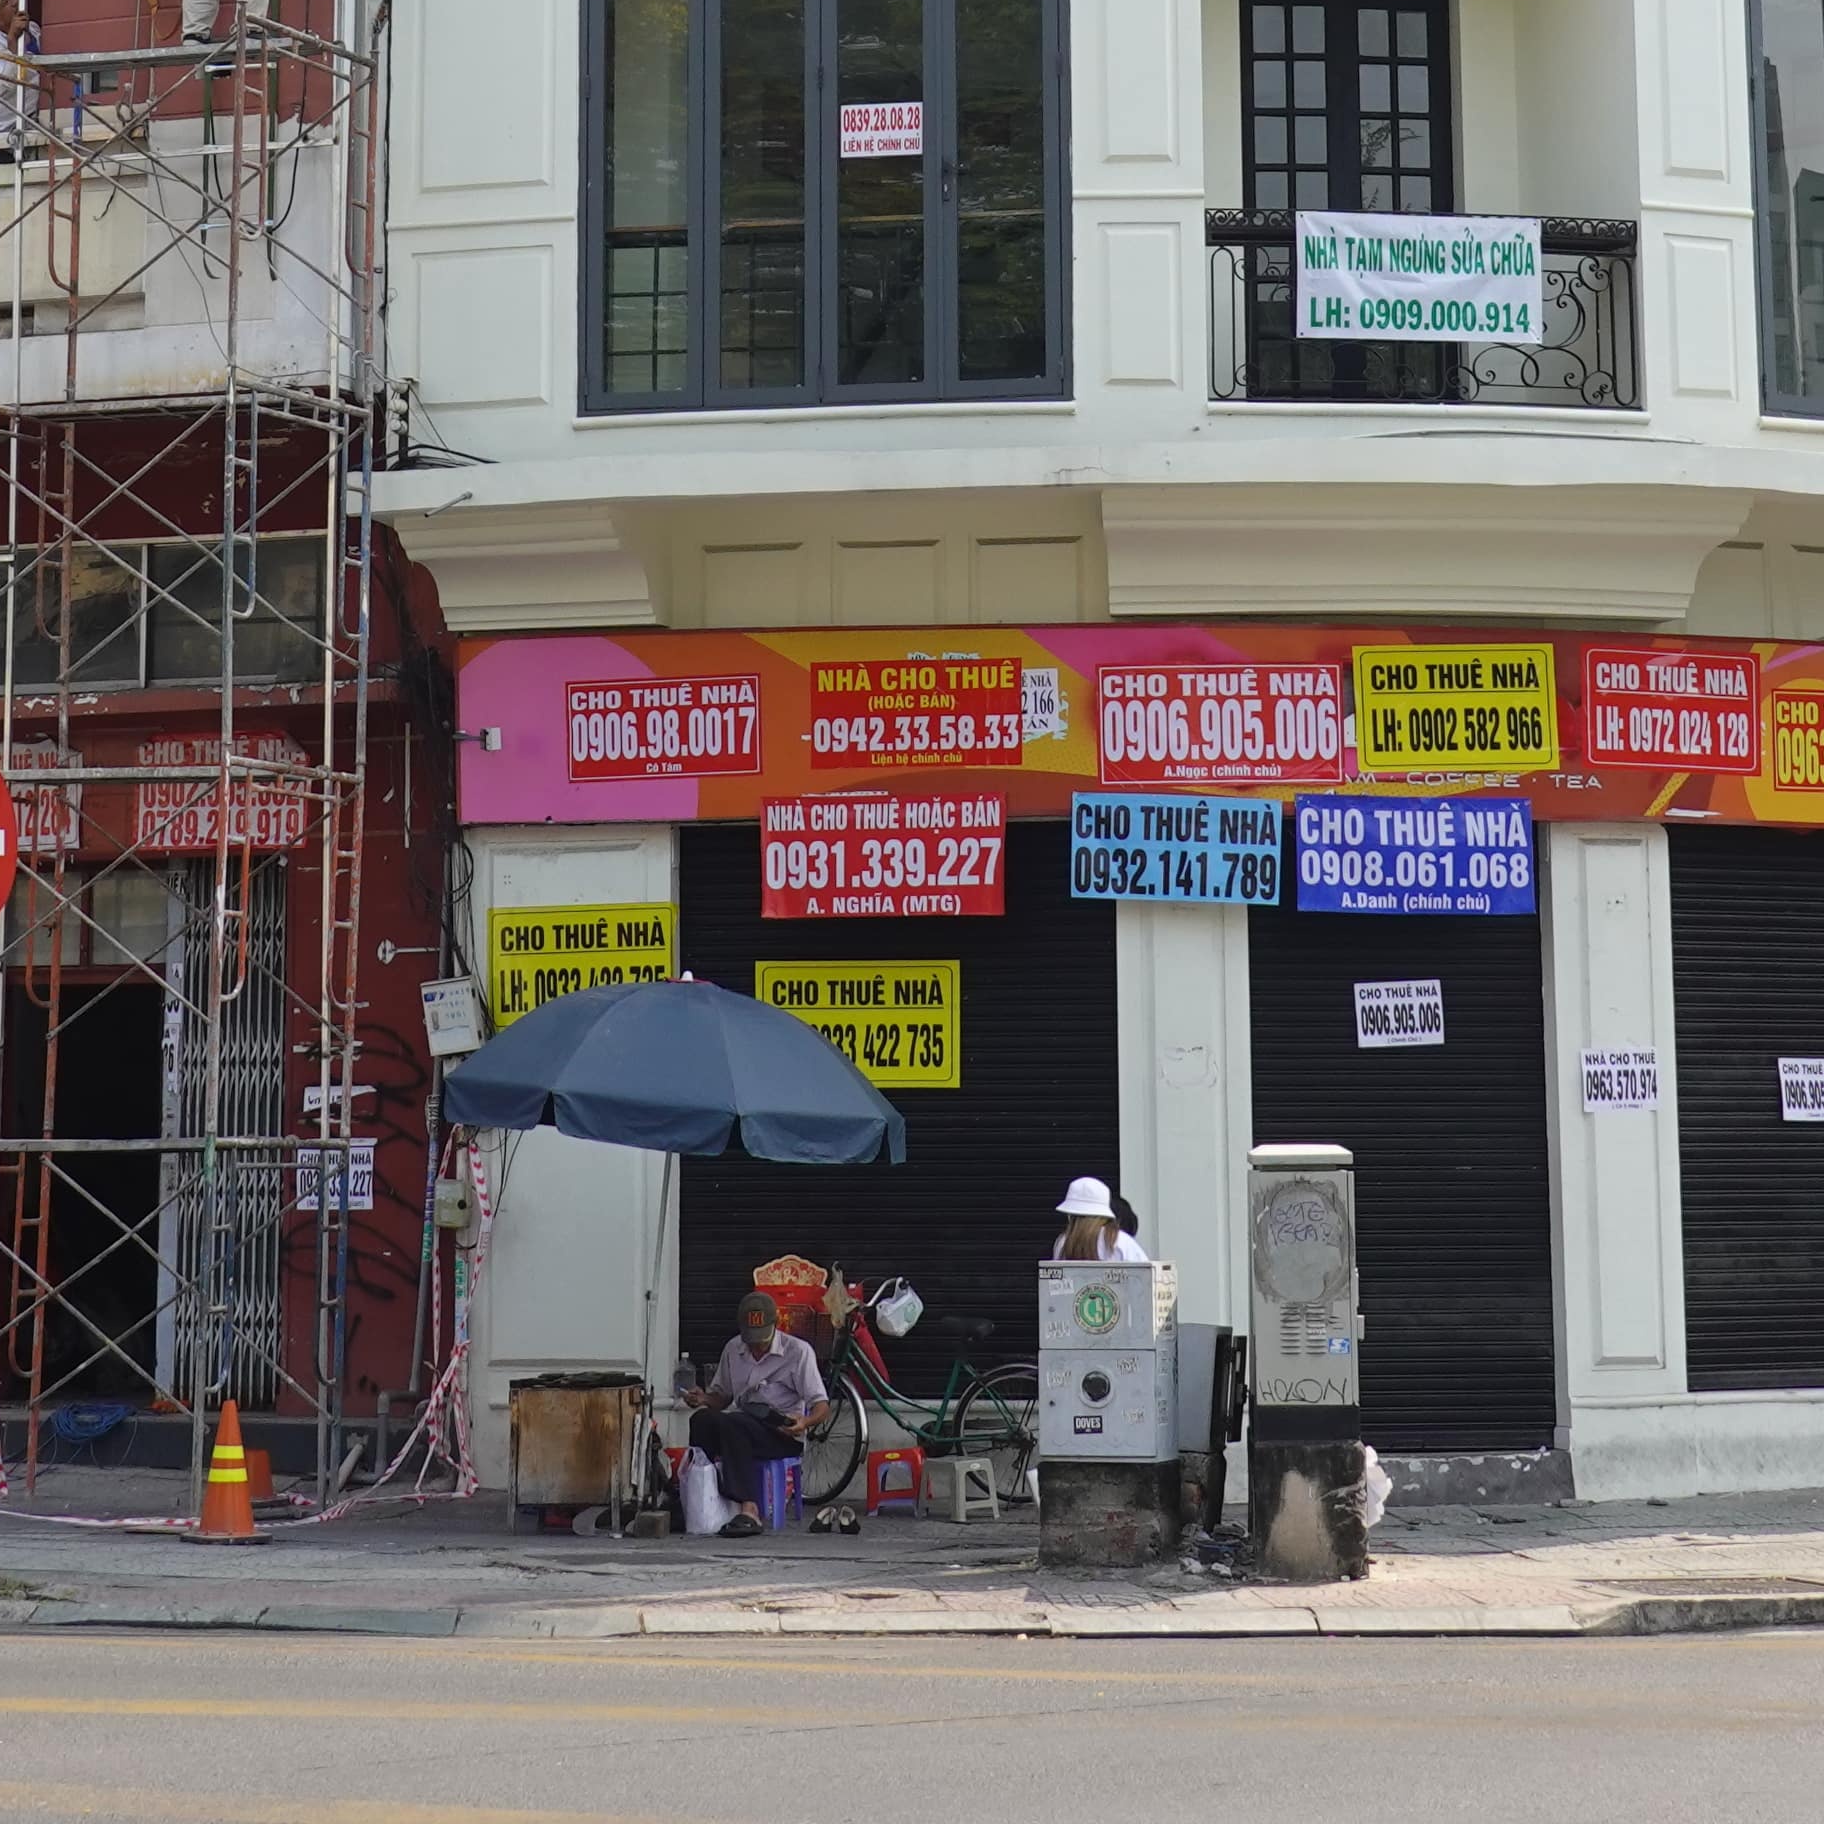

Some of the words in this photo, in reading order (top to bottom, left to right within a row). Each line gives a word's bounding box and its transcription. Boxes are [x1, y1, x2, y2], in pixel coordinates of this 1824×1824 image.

[844, 106, 920, 133] 0839.28.08.28
[844, 136, 862, 152] LIÊN
[864, 138, 874, 154] HỆ
[878, 132, 901, 150] CHÍNH
[904, 133, 920, 149] CHỦ
[1305, 227, 1338, 270] NHÀ
[1345, 238, 1383, 279] TẠM
[1390, 239, 1446, 274] NGƯNG
[1451, 227, 1485, 274] SỬA
[1490, 235, 1535, 277] CHỮA
[1310, 298, 1350, 328] LH:
[1360, 299, 1529, 333] 0909.000.914
[817, 664, 872, 692] NHÀ
[881, 667, 936, 690] CHO
[945, 660, 1015, 689] THUÊ
[1103, 675, 1167, 698] CHO
[1177, 669, 1261, 696] THUÊ
[1269, 668, 1336, 696] NHÀ
[1371, 666, 1417, 691] CHO
[1426, 659, 1484, 689] THUÊ
[1491, 662, 1540, 688] NHÀ
[1596, 663, 1639, 690] CHO
[1646, 662, 1699, 694] THUÊ
[1705, 664, 1748, 696] NHÀ
[572, 690, 621, 711] CHO
[630, 683, 692, 708] THUÊ
[702, 680, 755, 704] NHÀ
[868, 695, 915, 712] (HOẶC
[920, 692, 955, 710] BÁN)
[1777, 701, 1819, 724] CHO
[572, 707, 756, 762] 0906.98.0017
[814, 714, 1020, 752] 0942.33.58.33
[1103, 698, 1337, 762] 0906.905.006
[1374, 709, 1402, 754] LH:
[1408, 708, 1458, 751] 0902
[1464, 708, 1500, 751] 582
[1506, 708, 1542, 750] 966
[1596, 706, 1624, 750] LH:
[1629, 707, 1674, 753] 0972
[1679, 710, 1711, 755] 024
[1717, 712, 1749, 756] 128
[912, 752, 940, 763] chính
[944, 752, 962, 762] chủ
[1550, 775, 1602, 789] TEA
[767, 799, 805, 832] NHÀ
[811, 804, 848, 830] CHO
[854, 798, 900, 829] THUÊ
[905, 797, 955, 834] HOẶC
[961, 796, 1000, 827] BÁN
[1076, 803, 1131, 841] CHO
[1140, 801, 1209, 843] THUÊ
[1218, 803, 1277, 846] NHÀ
[1300, 808, 1365, 845] CHO
[1373, 803, 1455, 847] THUÊ
[1464, 802, 1527, 847] NHÀ
[766, 837, 1002, 889] 0931.339.227
[1075, 847, 1276, 899] 0932.141.789
[1301, 850, 1529, 888] 0908.061.068
[806, 898, 825, 914] A.
[833, 893, 895, 914] NGHĨA
[903, 895, 961, 916] (MTG)
[1341, 893, 1397, 910] A.Danh
[1402, 892, 1452, 912] (chính
[1456, 892, 1490, 913] chủ)
[1359, 989, 1381, 999] CHO
[1385, 984, 1412, 998] THUÊ
[1416, 983, 1438, 997] NHÀ
[1361, 1002, 1441, 1035] 0906.905.006
